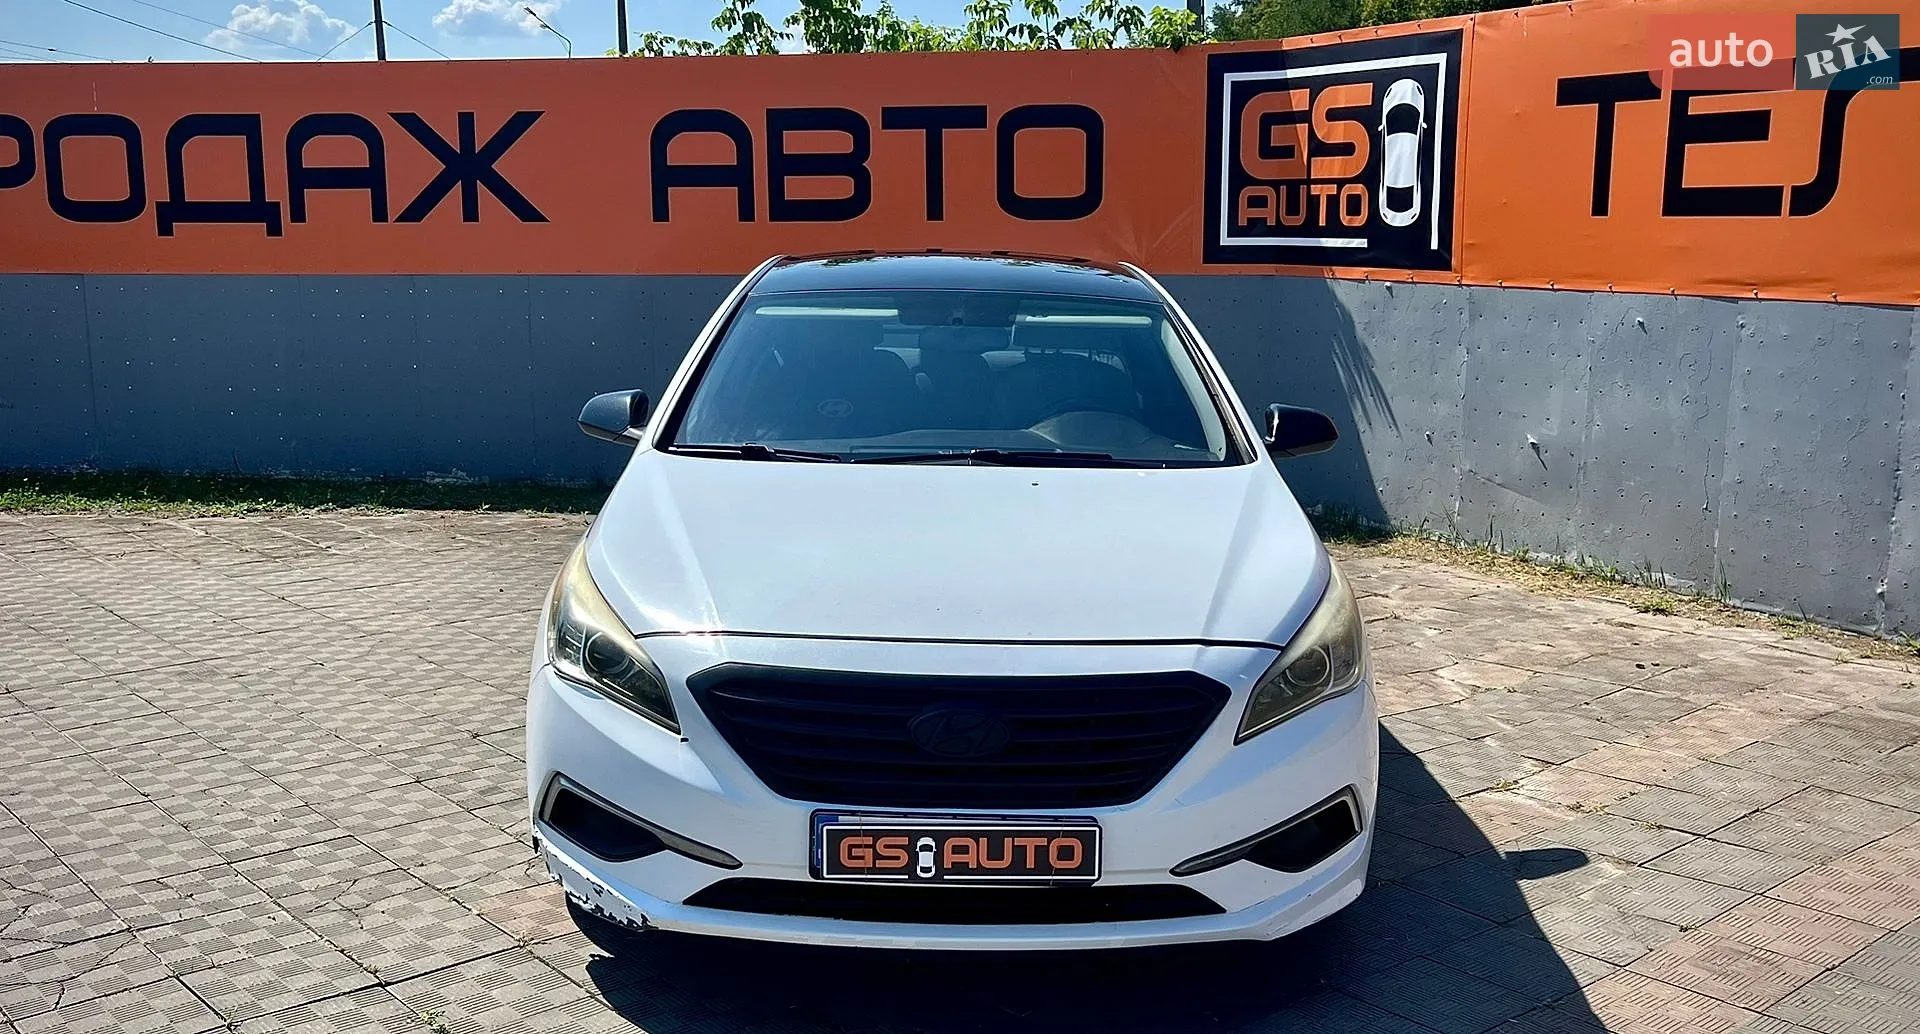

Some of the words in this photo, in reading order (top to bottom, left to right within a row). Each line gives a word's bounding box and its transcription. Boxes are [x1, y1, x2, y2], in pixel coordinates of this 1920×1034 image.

[650, 104, 1105, 222] АВТО
[1240, 82, 1374, 180] GS
[1237, 183, 1369, 227] AUTO
[839, 836, 909, 868] GS
[943, 837, 1083, 869] AUTO
